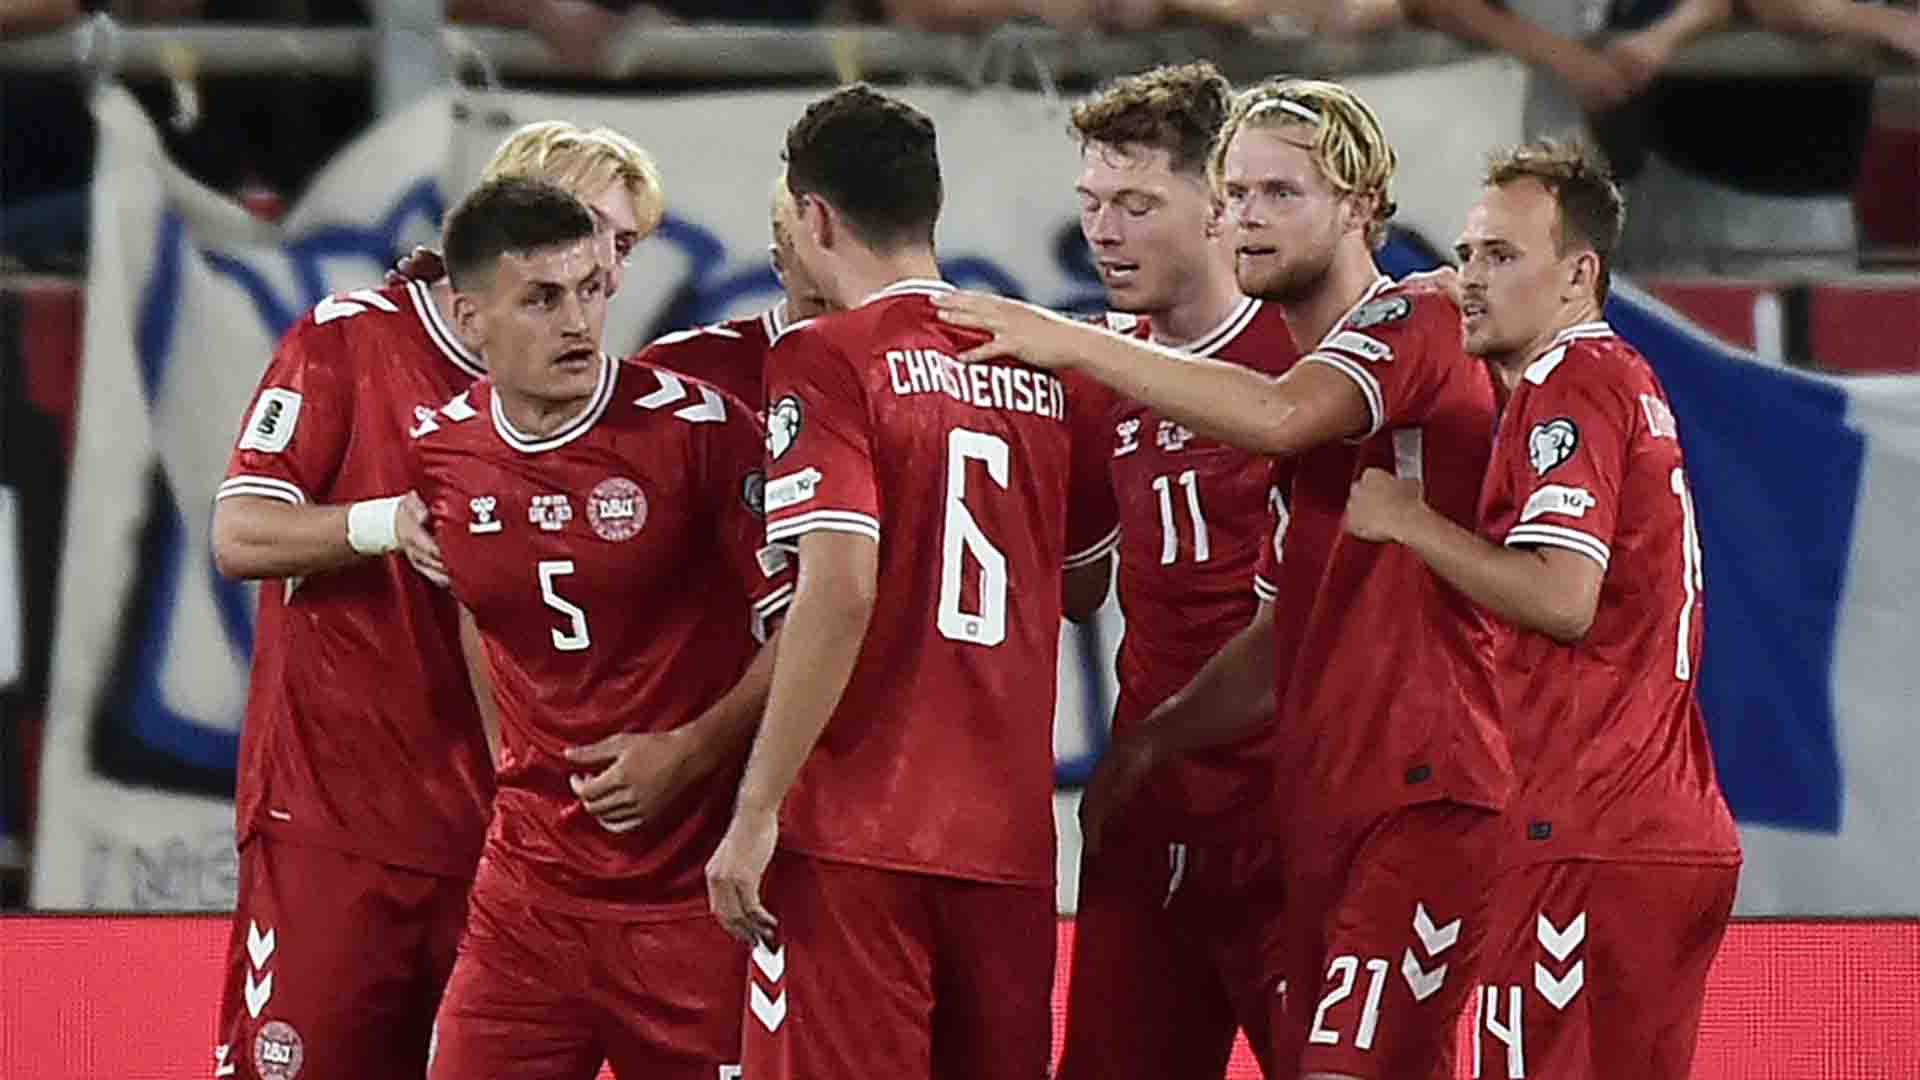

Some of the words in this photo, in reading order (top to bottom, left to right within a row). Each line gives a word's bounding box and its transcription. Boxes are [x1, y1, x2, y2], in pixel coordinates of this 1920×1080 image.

[885, 349, 1065, 421] CHRSTENSEN
[937, 427, 1009, 647] 6
[1152, 469, 1209, 565] 11
[538, 561, 591, 651] 5
[1309, 955, 1389, 1050] 21
[1472, 984, 1525, 1079] 14
